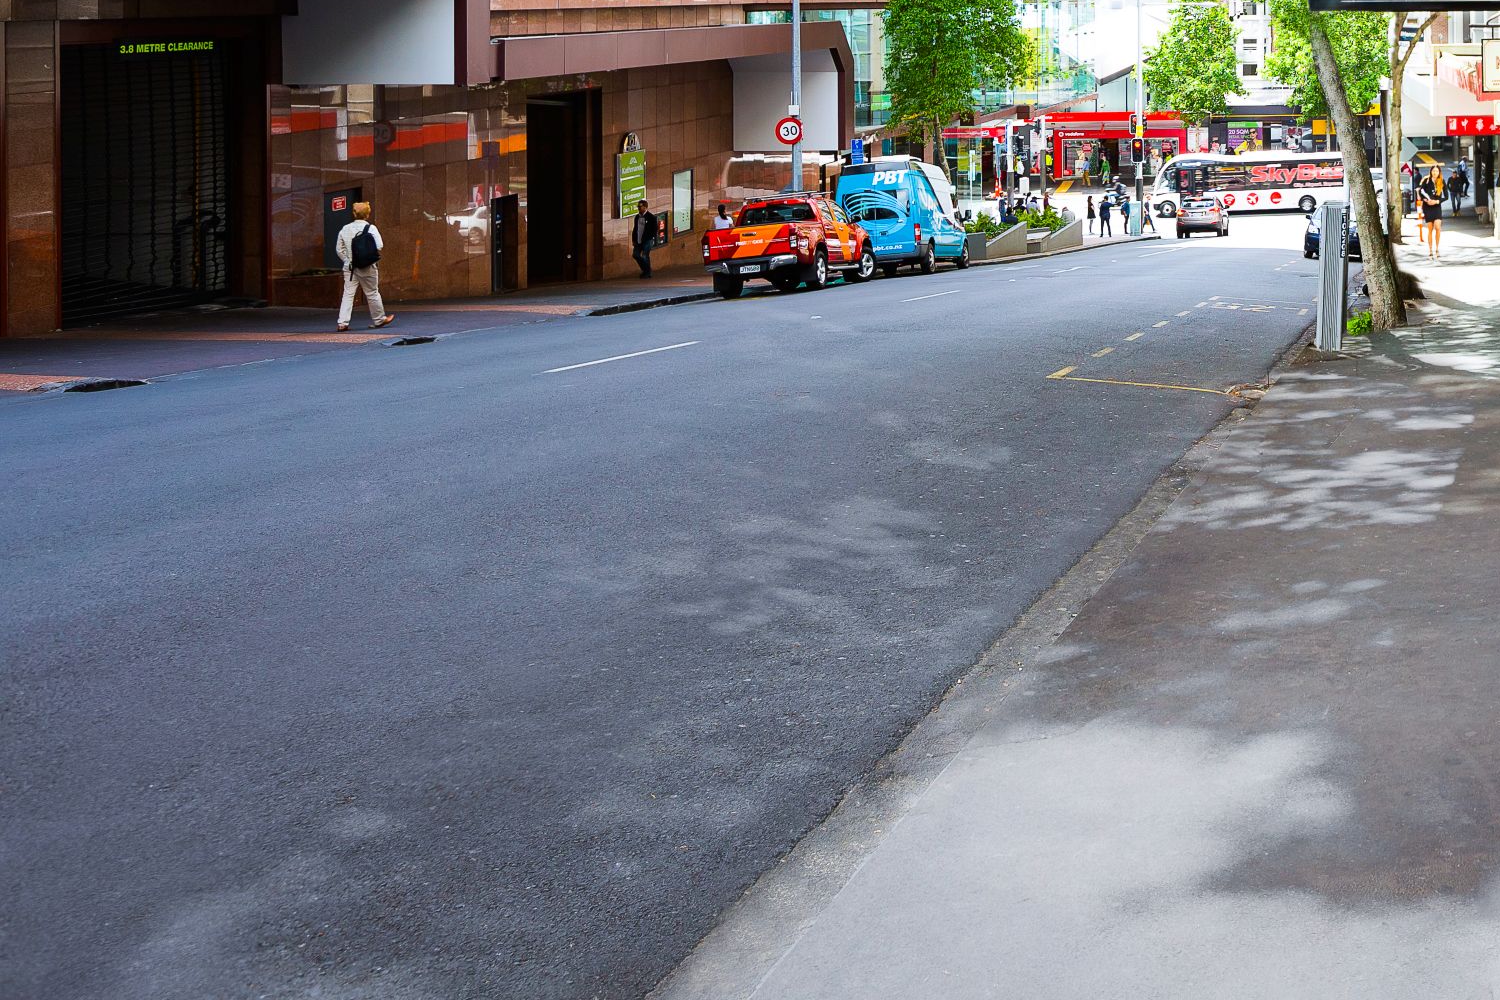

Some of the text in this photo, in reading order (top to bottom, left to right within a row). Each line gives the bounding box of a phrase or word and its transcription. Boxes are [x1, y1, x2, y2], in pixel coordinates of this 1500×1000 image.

[120, 41, 214, 54] 3.8 METRE CLEARANCE
[782, 125, 798, 137] 30
[871, 169, 909, 186] PBT
[1250, 163, 1344, 185] SkyBus
